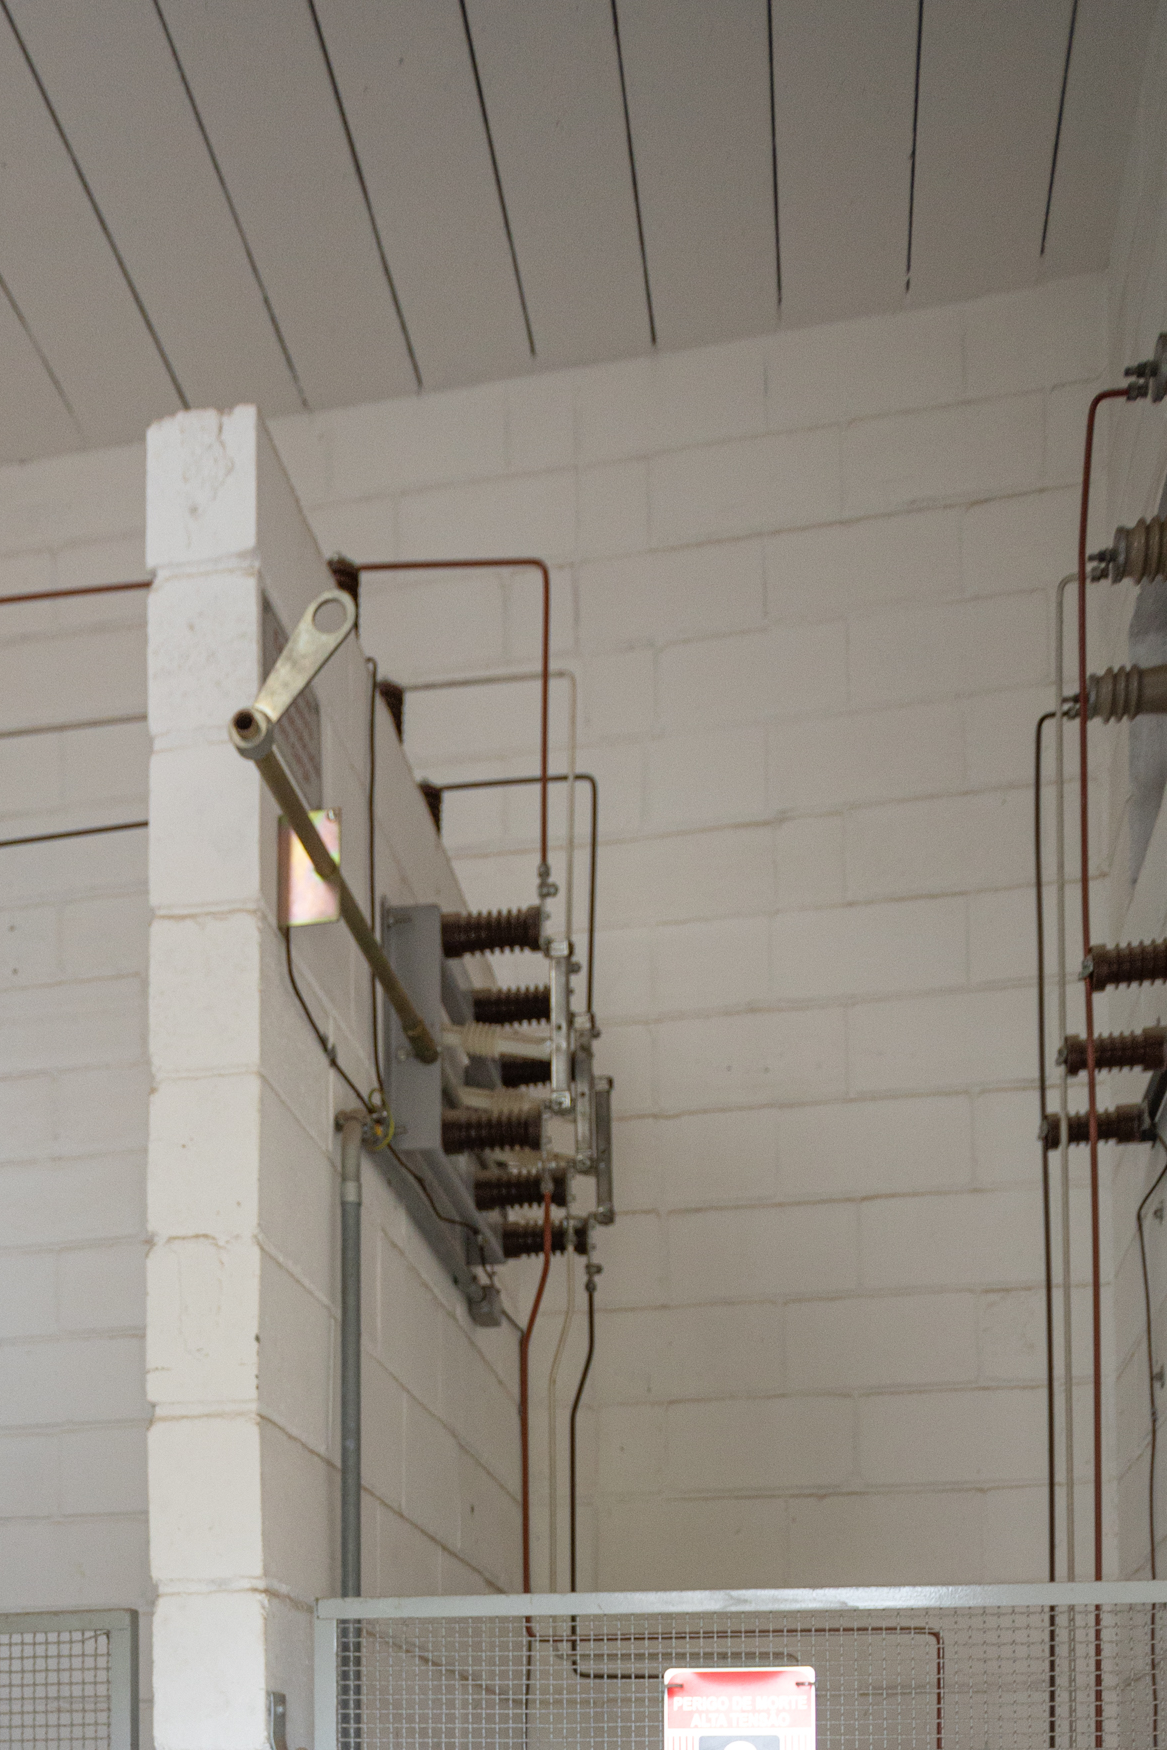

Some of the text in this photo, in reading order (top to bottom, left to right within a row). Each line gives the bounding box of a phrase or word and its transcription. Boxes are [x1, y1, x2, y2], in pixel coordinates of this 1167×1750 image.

[672, 1695, 809, 1711] PERIGO DE MORTE
[690, 1709, 791, 1727] ALTA TENSÃO
